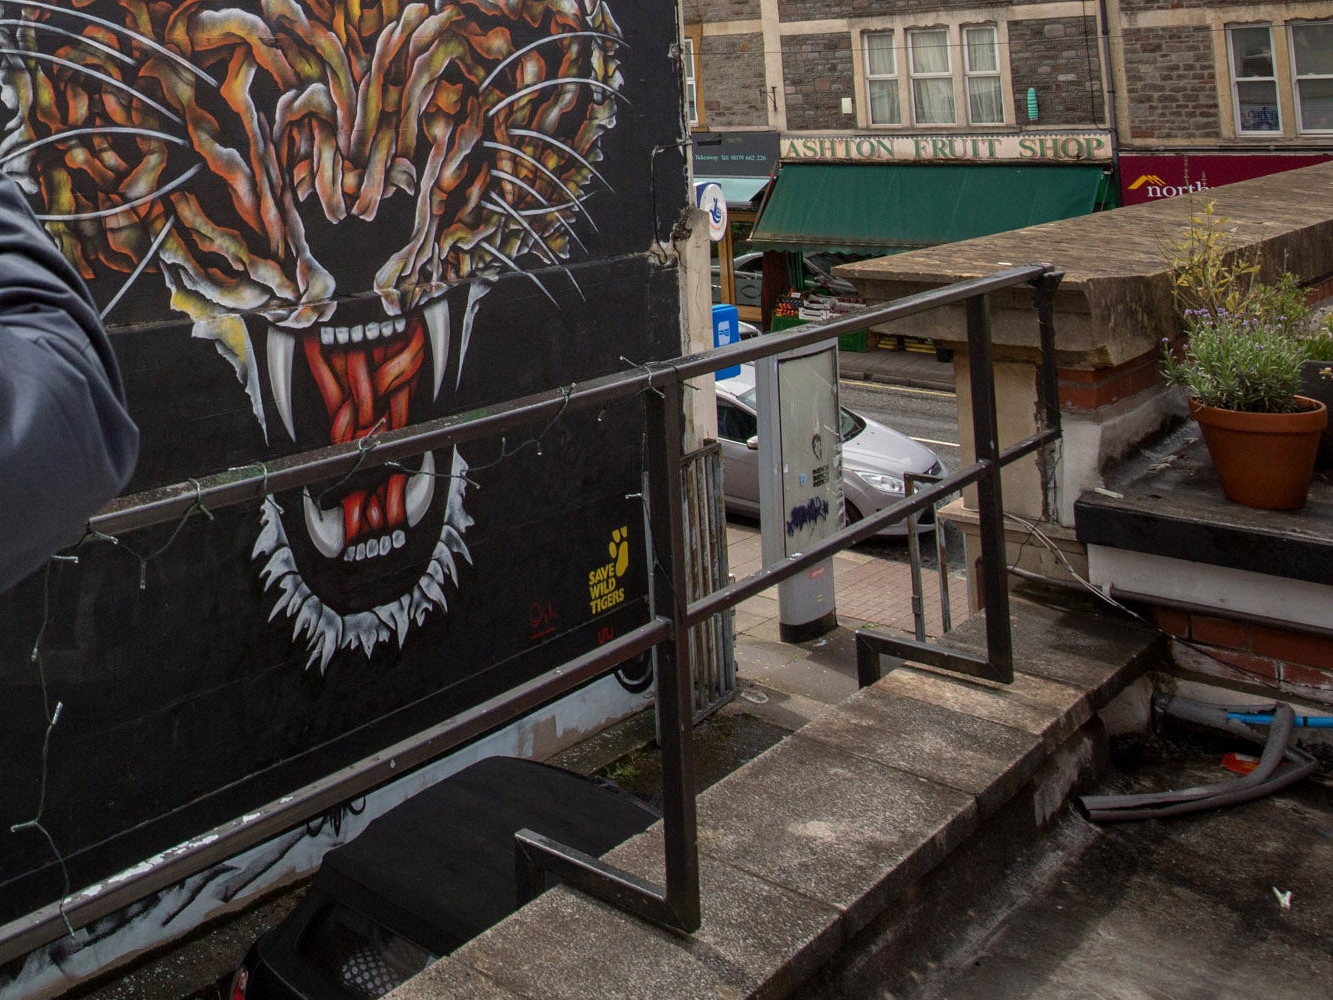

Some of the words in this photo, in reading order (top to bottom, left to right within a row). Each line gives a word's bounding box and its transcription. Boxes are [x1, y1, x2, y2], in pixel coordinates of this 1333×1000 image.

[787, 138, 895, 158] ASHTON
[913, 138, 1001, 158] FRUIT
[1019, 137, 1104, 158] SHOP
[589, 562, 615, 585] SAVE
[589, 578, 616, 600] WILD
[590, 588, 624, 614] TIGERS
